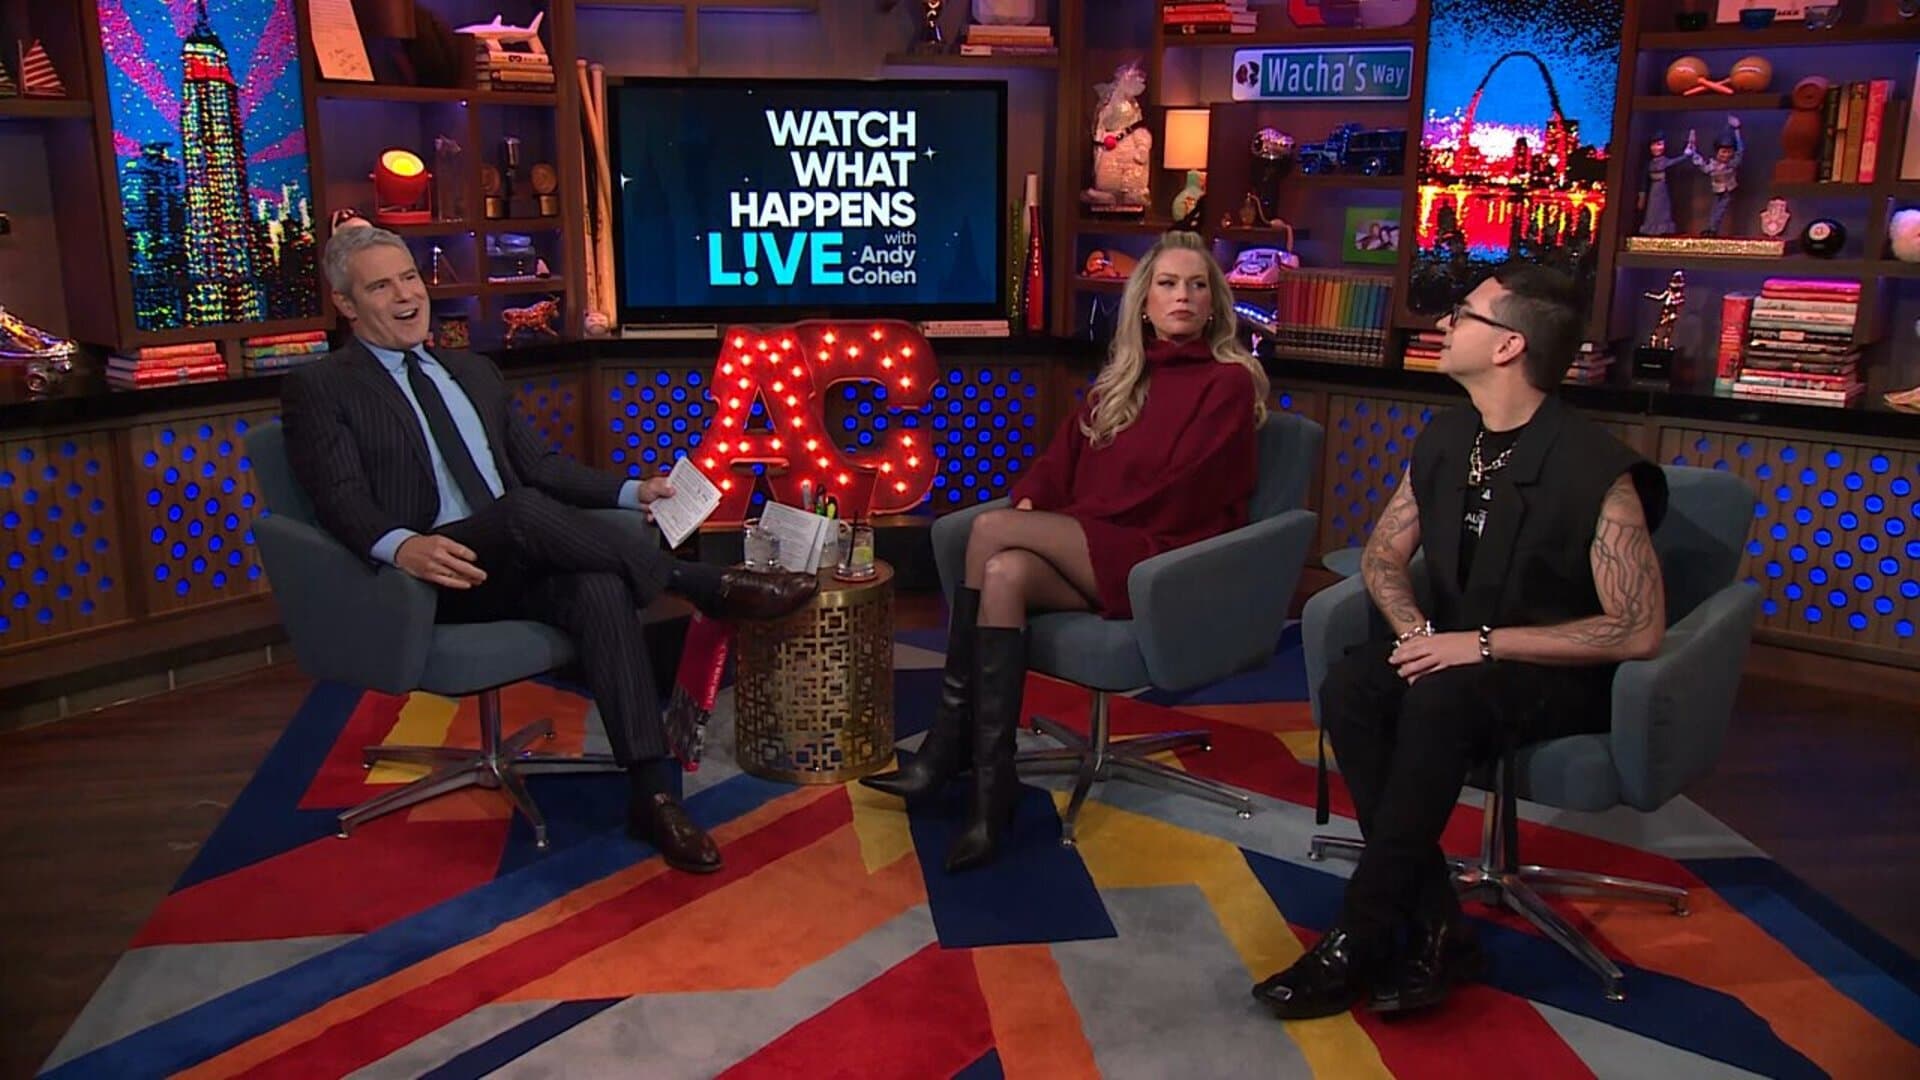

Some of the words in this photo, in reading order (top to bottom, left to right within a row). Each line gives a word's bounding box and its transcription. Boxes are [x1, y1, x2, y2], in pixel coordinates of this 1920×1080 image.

[1268, 54, 1367, 94] Wacha's
[1372, 64, 1405, 88] Way
[765, 110, 916, 147] WATCH
[790, 151, 916, 187] WHAT
[730, 191, 916, 228] HAPPENS
[884, 230, 916, 245] with
[708, 231, 844, 286] L!VE
[860, 247, 916, 266] Andy
[848, 266, 916, 285] Cohen
